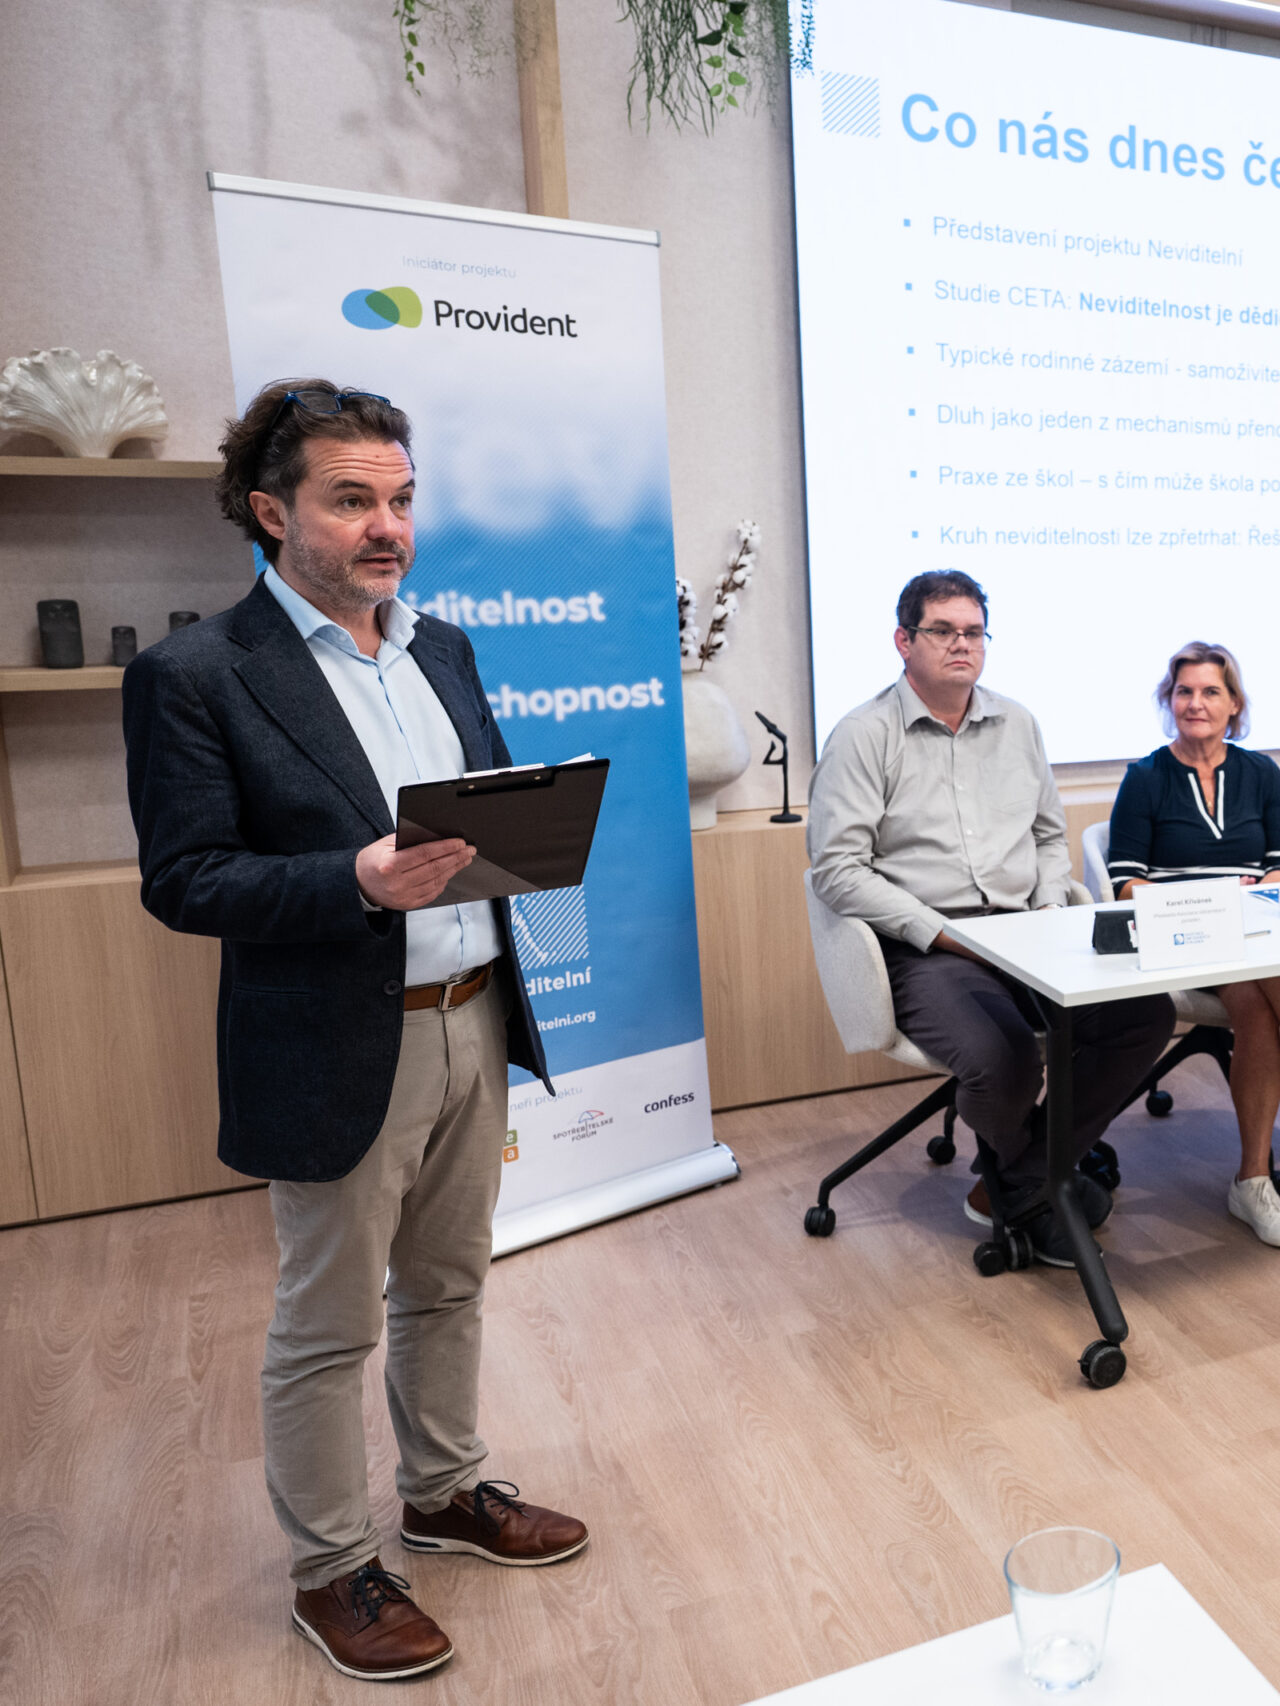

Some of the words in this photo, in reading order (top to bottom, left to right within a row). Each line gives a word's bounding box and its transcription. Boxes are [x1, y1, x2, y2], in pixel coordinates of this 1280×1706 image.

[900, 92, 976, 148] Co
[998, 110, 1089, 163] nás
[1108, 124, 1225, 181] dnes
[932, 215, 1056, 248] Představení
[1063, 232, 1141, 257] projektu
[1147, 238, 1242, 266] Neviditelní
[402, 255, 457, 272] Iniciátor
[462, 263, 517, 279] projektu
[434, 300, 578, 338] Provident
[934, 279, 1000, 304] Studie
[1079, 291, 1211, 320] Neviditelnost
[1215, 303, 1232, 326] je
[935, 341, 1014, 368] Typické
[1020, 349, 1095, 371] rodinné
[1100, 354, 1168, 375] zázemí
[936, 403, 984, 424] Dluh
[990, 406, 1032, 430] jako
[1038, 409, 1092, 432] jeden
[1097, 415, 1110, 431] z
[1114, 415, 1231, 436] mechanismů
[938, 464, 998, 486] Praxe
[1004, 471, 1028, 486] ze
[1034, 467, 1073, 488] škol
[1097, 473, 1108, 488] s
[1113, 470, 1148, 488] čím
[1153, 471, 1203, 491] může
[1208, 472, 1254, 492] škola
[939, 525, 987, 544] Kruh
[994, 526, 1120, 545] neviditelnosti
[1126, 527, 1152, 546] lze
[404, 590, 606, 628] iditelnost
[487, 677, 665, 722] chopnost
[525, 966, 592, 996] ditelní
[536, 1010, 596, 1032] itelni.org
[509, 1097, 532, 1112] neři
[644, 1092, 695, 1113] confess
